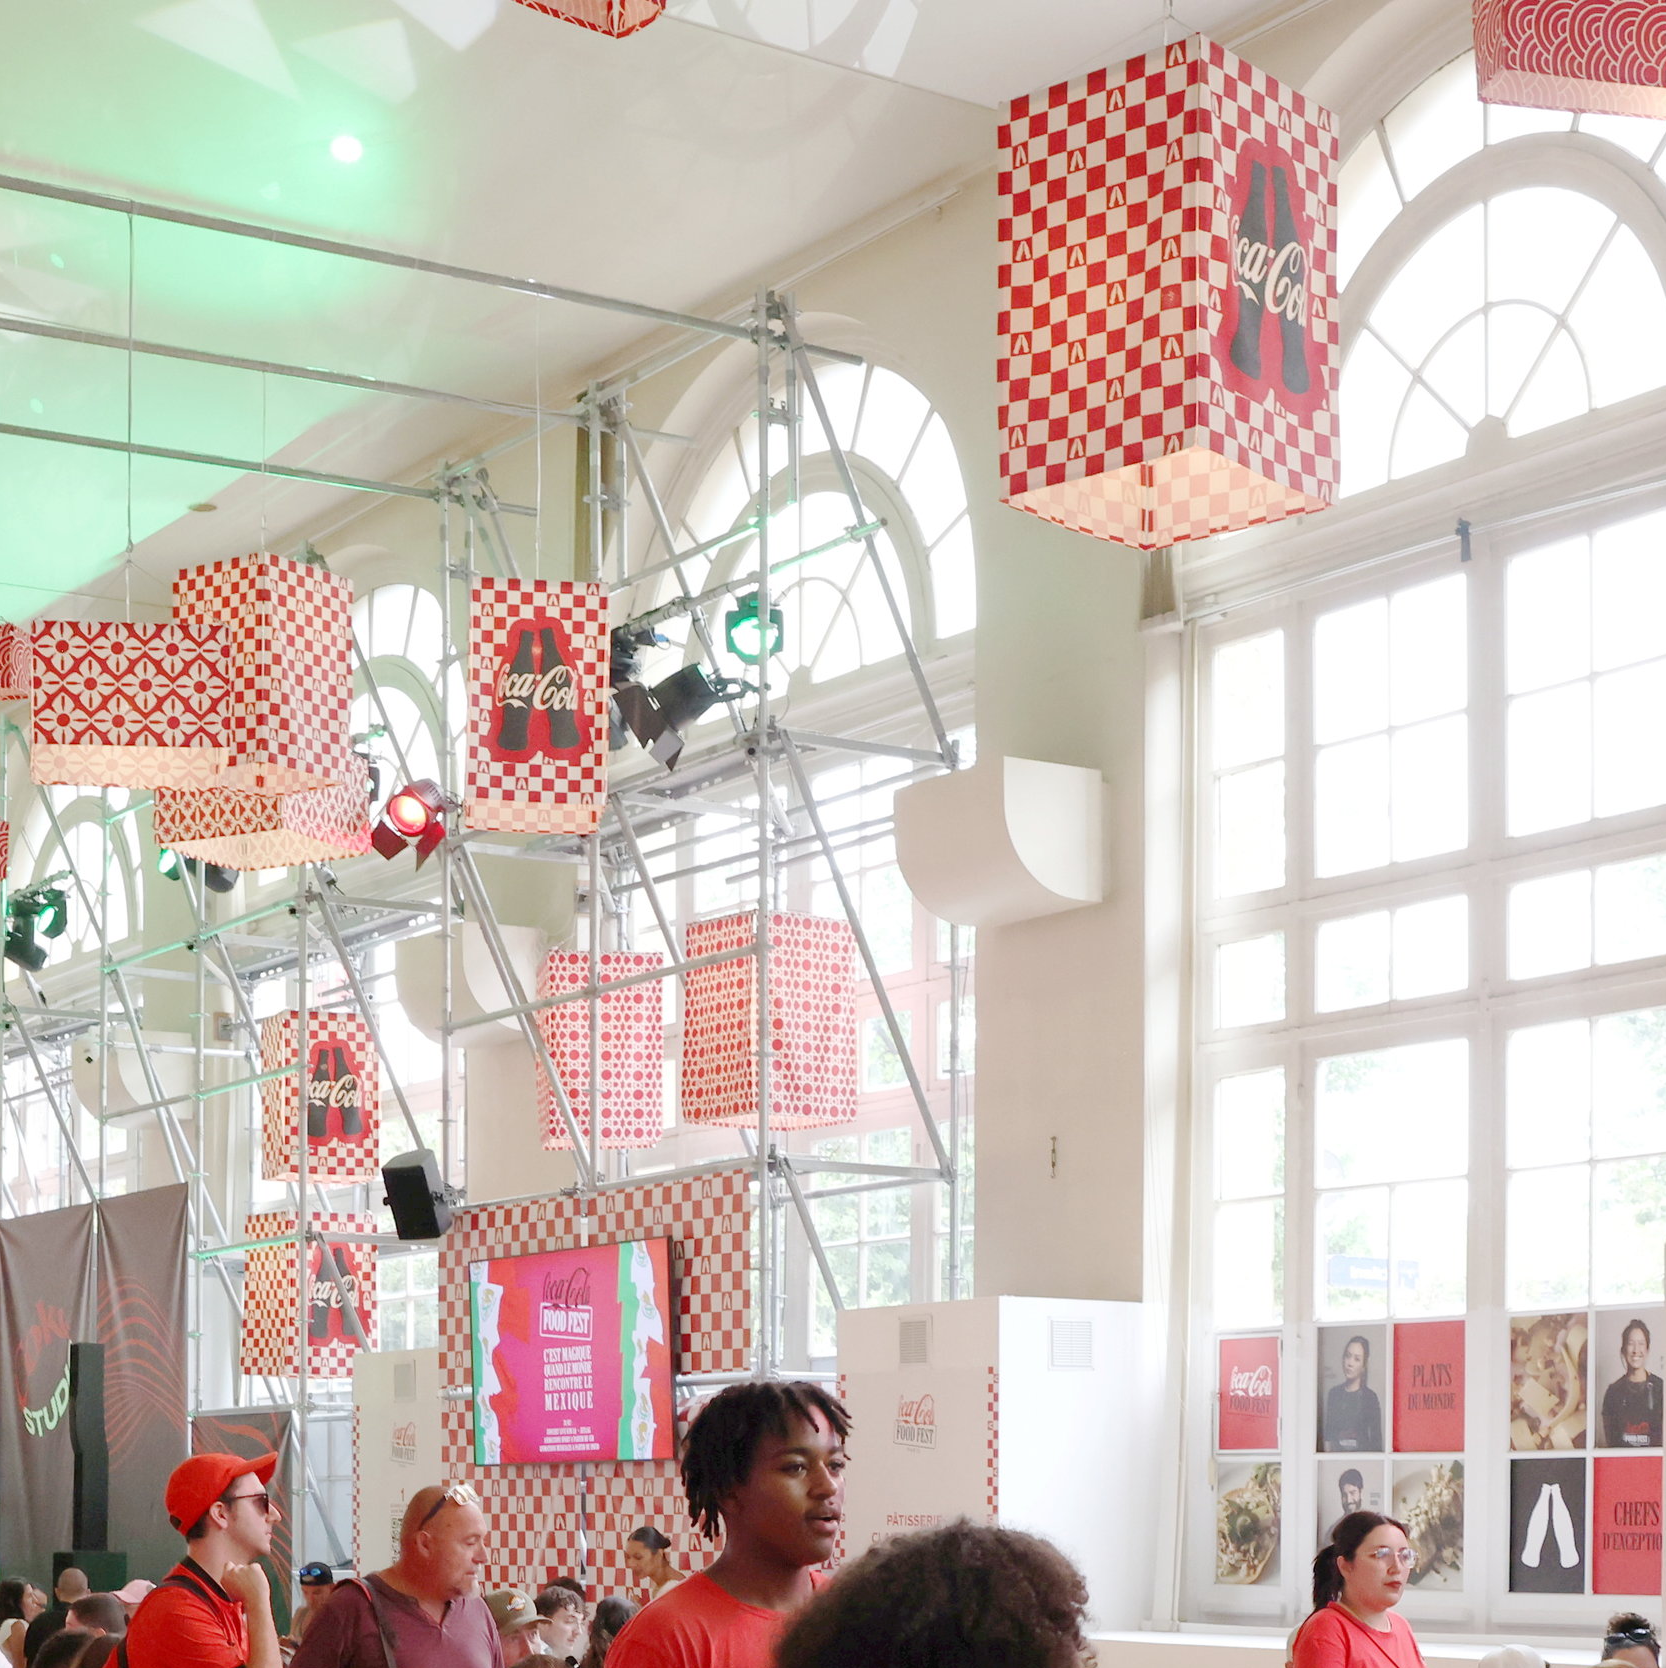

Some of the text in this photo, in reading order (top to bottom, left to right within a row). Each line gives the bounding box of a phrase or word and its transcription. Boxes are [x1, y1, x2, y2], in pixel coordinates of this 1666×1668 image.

[1229, 213, 1310, 328] Coca-Cola
[495, 662, 579, 711] Coca-Cola
[542, 1267, 590, 1310] Coca-Cola
[543, 1308, 590, 1335] FOOD FEST
[562, 1345, 592, 1362] MAGIQUE
[544, 1361, 593, 1378] QUAND LE MONDE
[1229, 1365, 1273, 1397] Coca-Cola
[1412, 1363, 1453, 1388] PLATS
[544, 1375, 593, 1392] RENCONTRE LE
[23, 1363, 71, 1437] STUDI
[545, 1391, 594, 1412] MEXIQUE
[1407, 1392, 1456, 1411] DU MONDE
[896, 1424, 935, 1445] FOOD FEST
[1615, 1501, 1661, 1527] CHEFS
[1602, 1532, 1663, 1552] D'EXCEPTIO
